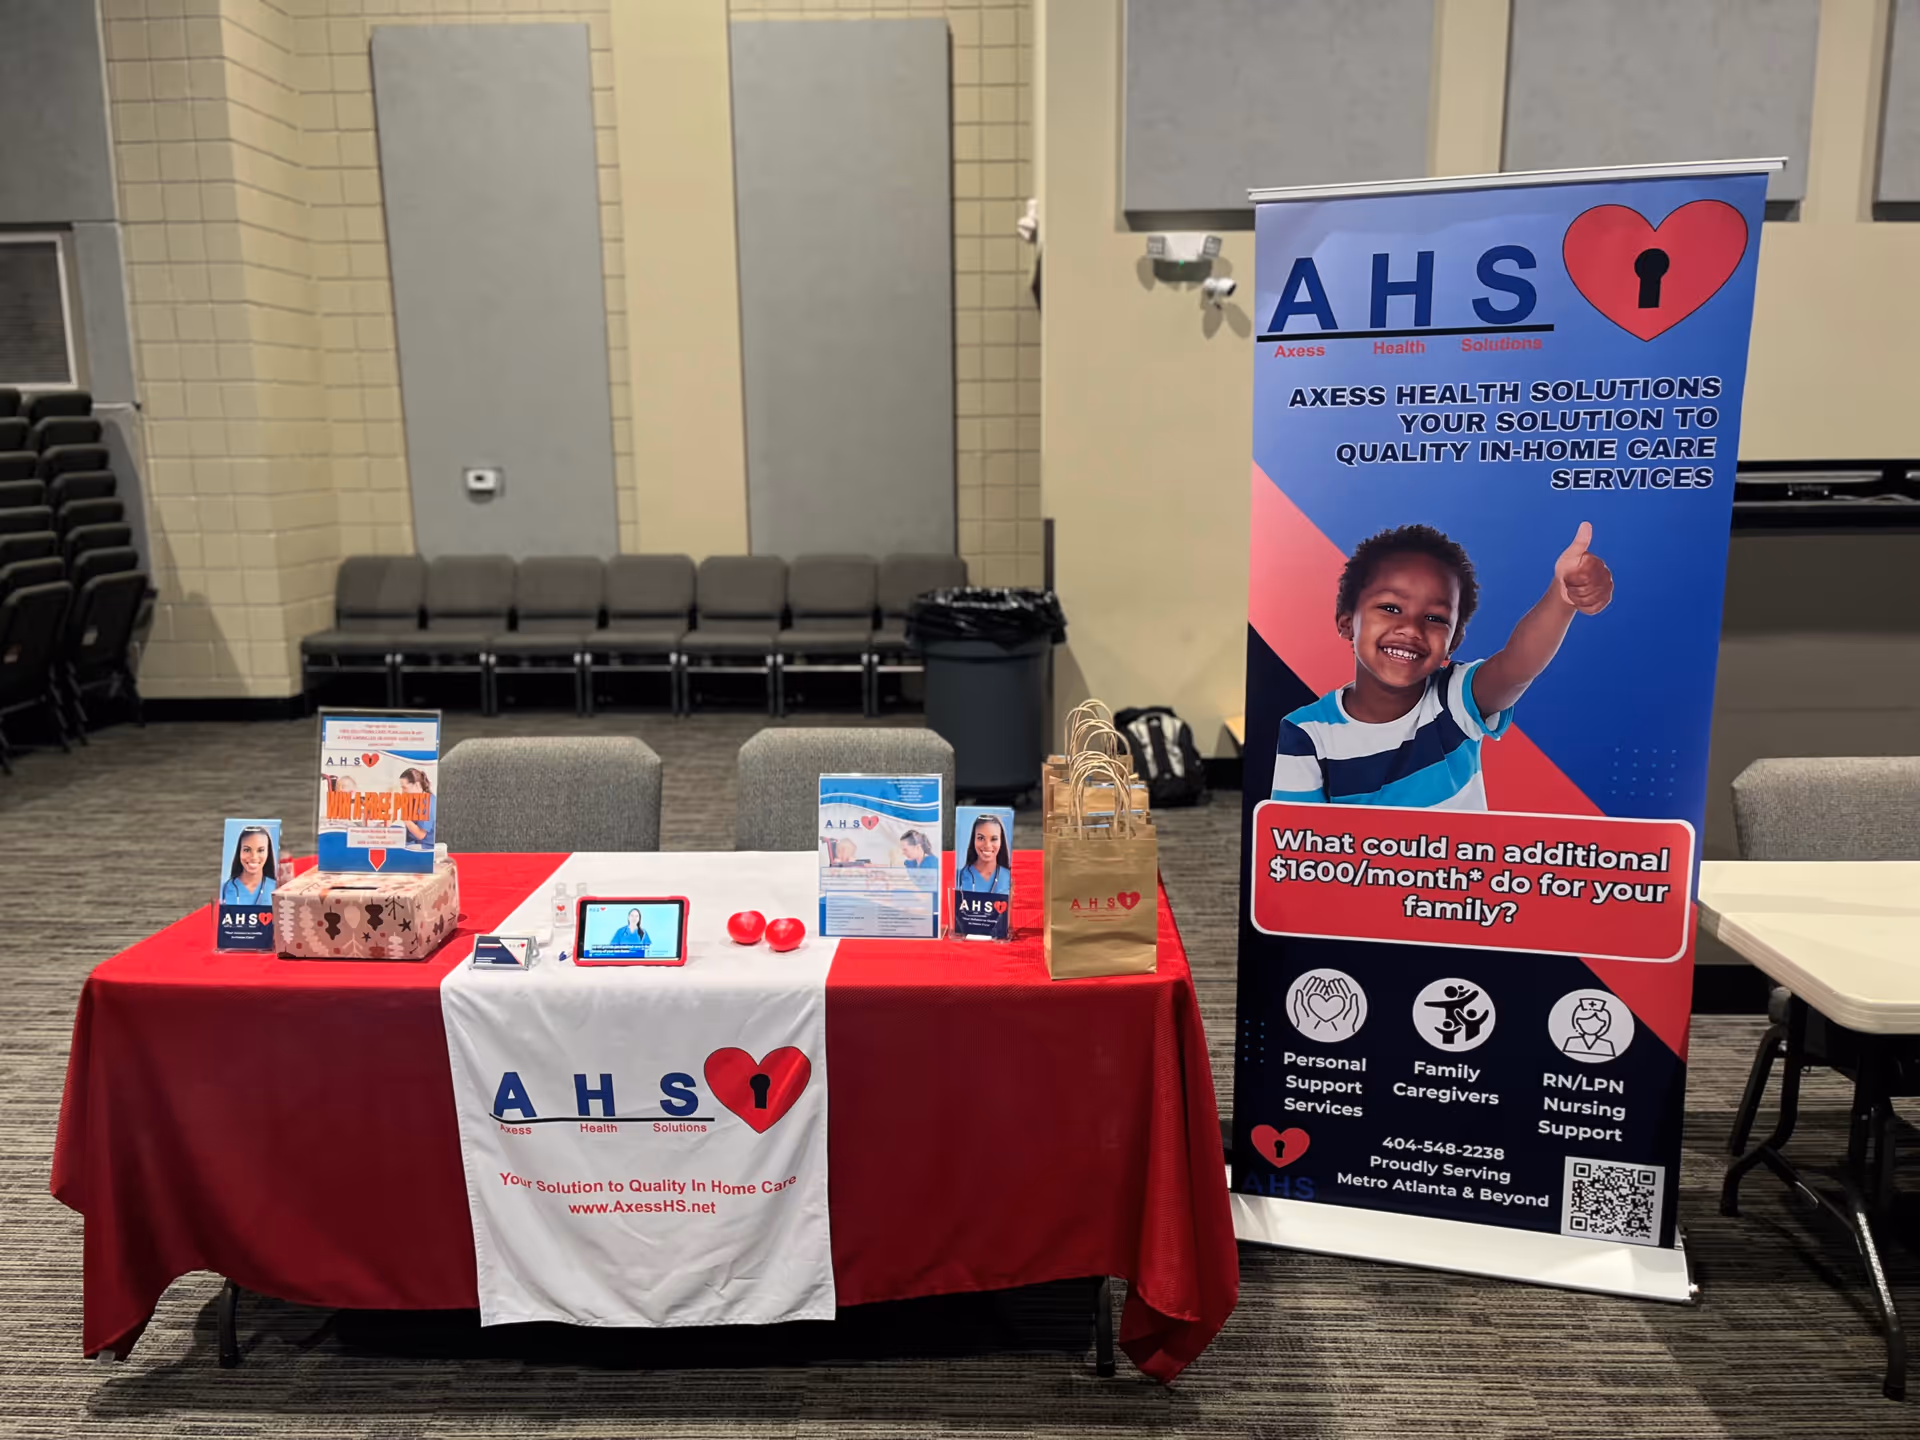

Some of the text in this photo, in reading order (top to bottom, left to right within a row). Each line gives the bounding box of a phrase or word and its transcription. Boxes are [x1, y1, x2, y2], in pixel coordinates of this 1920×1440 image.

[1274, 337, 1542, 358] Axess Health Solutions
[1288, 376, 1721, 408] AXESS HEALTH SOLUTIONS
[1399, 406, 1718, 435] YOUR SOLUTION TO
[1336, 436, 1717, 466] QUALITY IN-HOME CARE
[1551, 467, 1714, 490] SERVICES
[326, 791, 351, 820] WIN
[364, 791, 391, 821] FREE
[1271, 827, 1670, 872] What could an additional
[1490, 871, 1531, 895] do
[1539, 874, 1585, 898] for
[1592, 880, 1670, 904] your
[1403, 895, 1518, 927] family?
[1283, 1052, 1367, 1072] Personal
[1413, 1060, 1481, 1083] Family
[1285, 1074, 1363, 1095] Support
[1392, 1082, 1499, 1106] Caregivers
[1542, 1072, 1624, 1095] RN/LPN
[1283, 1097, 1363, 1117] Services
[1543, 1097, 1626, 1122] Nursing
[500, 1122, 707, 1135] Axess Health Solutions
[1538, 1119, 1623, 1142] Support
[1382, 1136, 1505, 1161] 404-548-2238
[1369, 1155, 1511, 1185] Proudly Serving
[499, 1172, 797, 1195] Your Solution to Quality In Home Care
[1242, 1171, 1315, 1200] AHS
[1337, 1172, 1550, 1208] Metro Atlanta & Beyond
[568, 1201, 716, 1215] www.AxessHS.net
